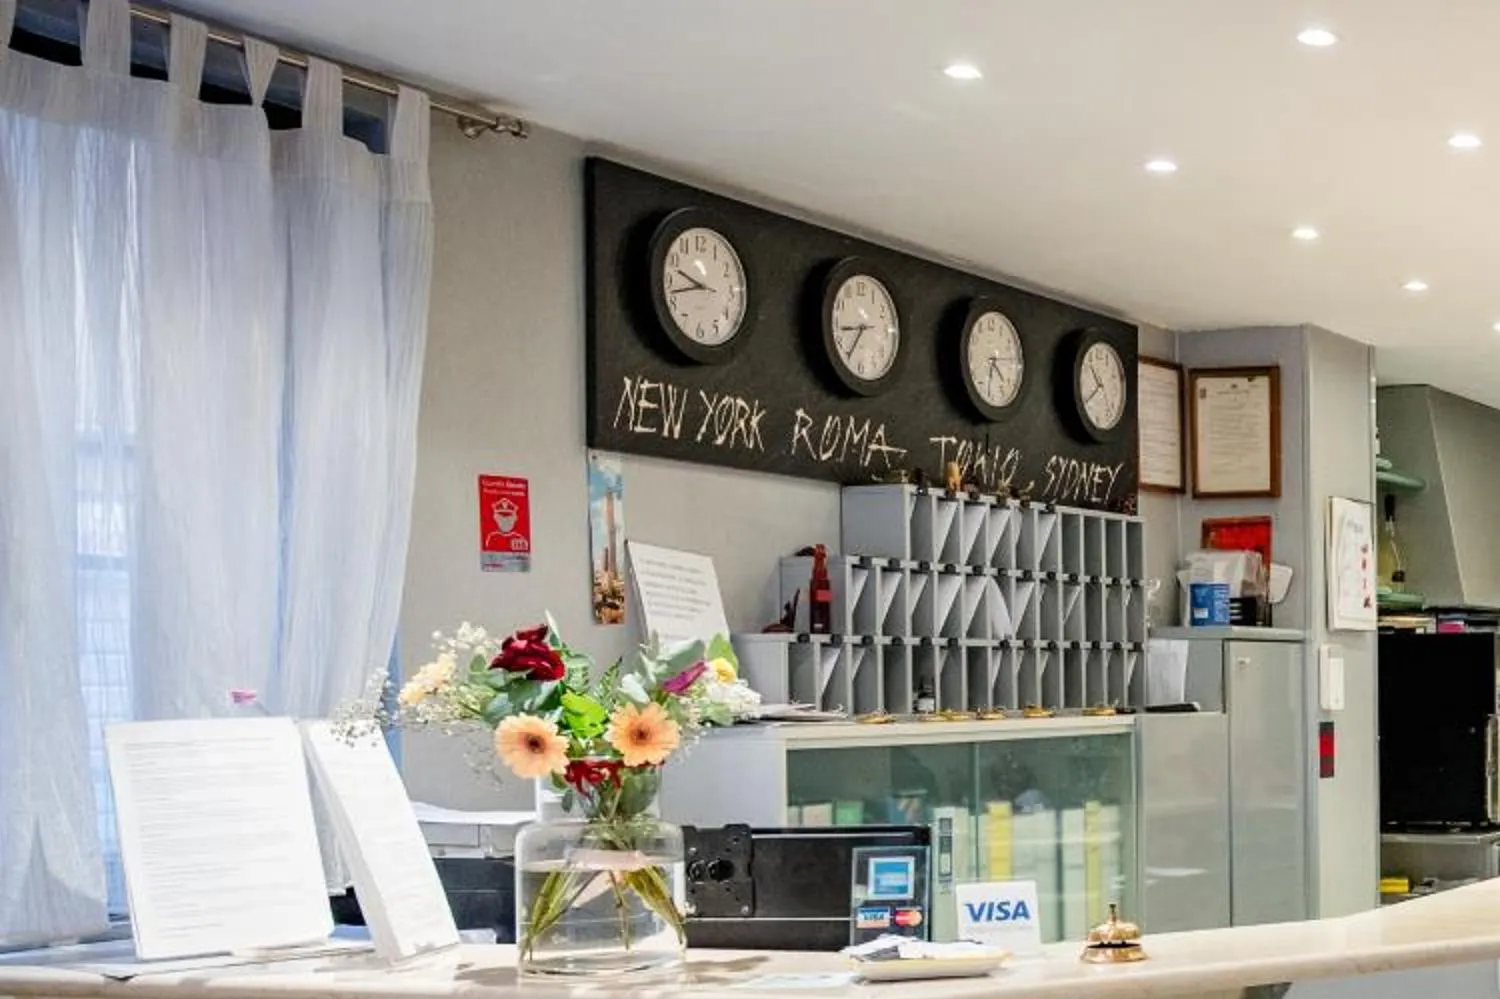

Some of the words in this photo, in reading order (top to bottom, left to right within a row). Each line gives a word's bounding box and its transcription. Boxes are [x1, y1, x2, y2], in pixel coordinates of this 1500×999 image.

[679, 237, 689, 255] 11
[695, 235, 707, 253] 12
[695, 322, 705, 339] 6
[613, 374, 688, 440] NEW
[695, 389, 767, 453] YORK
[791, 408, 908, 469] ROMA
[1043, 454, 1125, 502] SYDNEY
[965, 899, 1031, 922] VISA
